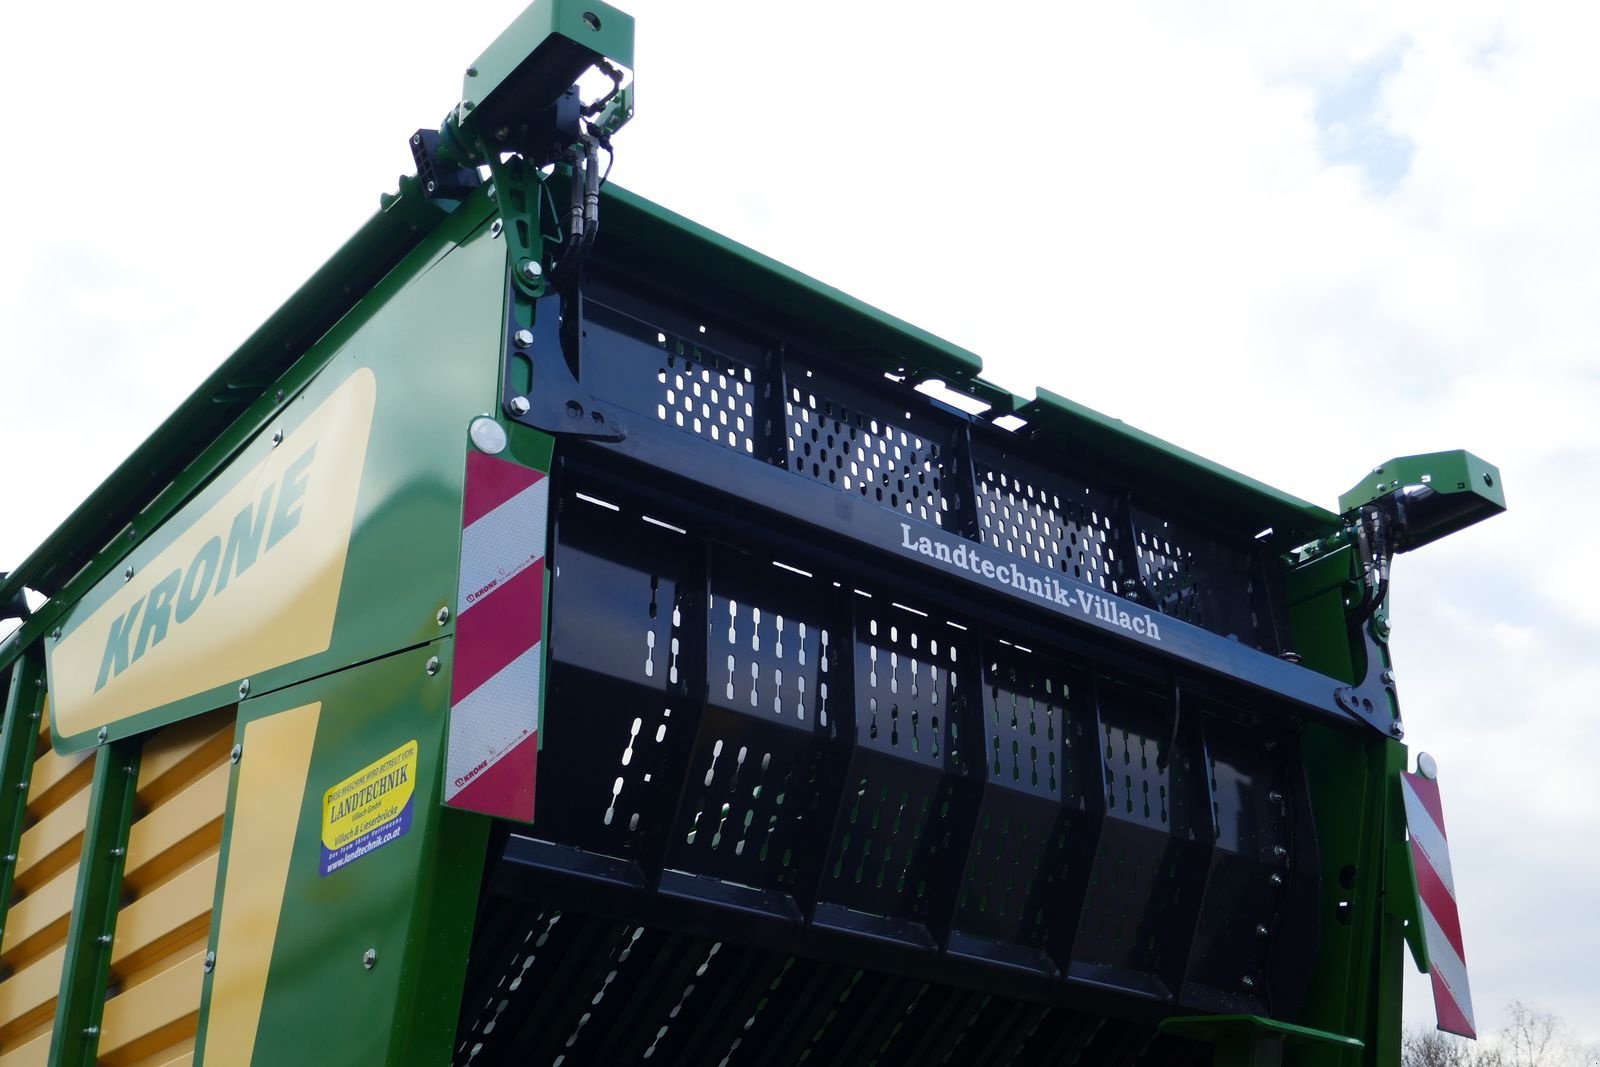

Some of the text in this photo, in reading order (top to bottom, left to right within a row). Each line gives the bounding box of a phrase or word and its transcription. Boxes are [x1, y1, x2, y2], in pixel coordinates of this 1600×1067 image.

[93, 440, 318, 695] KRONE
[474, 579, 498, 599] KRONE
[900, 522, 1161, 641] Landtechnik-Villach
[328, 791, 343, 805] DIESE
[342, 775, 366, 795] MASCHINE
[366, 768, 379, 781] WIRD
[380, 755, 401, 773] BETREUT
[331, 764, 408, 824] LANDTECHNIK
[463, 760, 488, 783] KRONE
[334, 828, 353, 846] Villach
[360, 805, 398, 833] Lieserbrücke
[367, 800, 382, 813] GmbH
[327, 827, 401, 873] www.landtechnik.co.at
